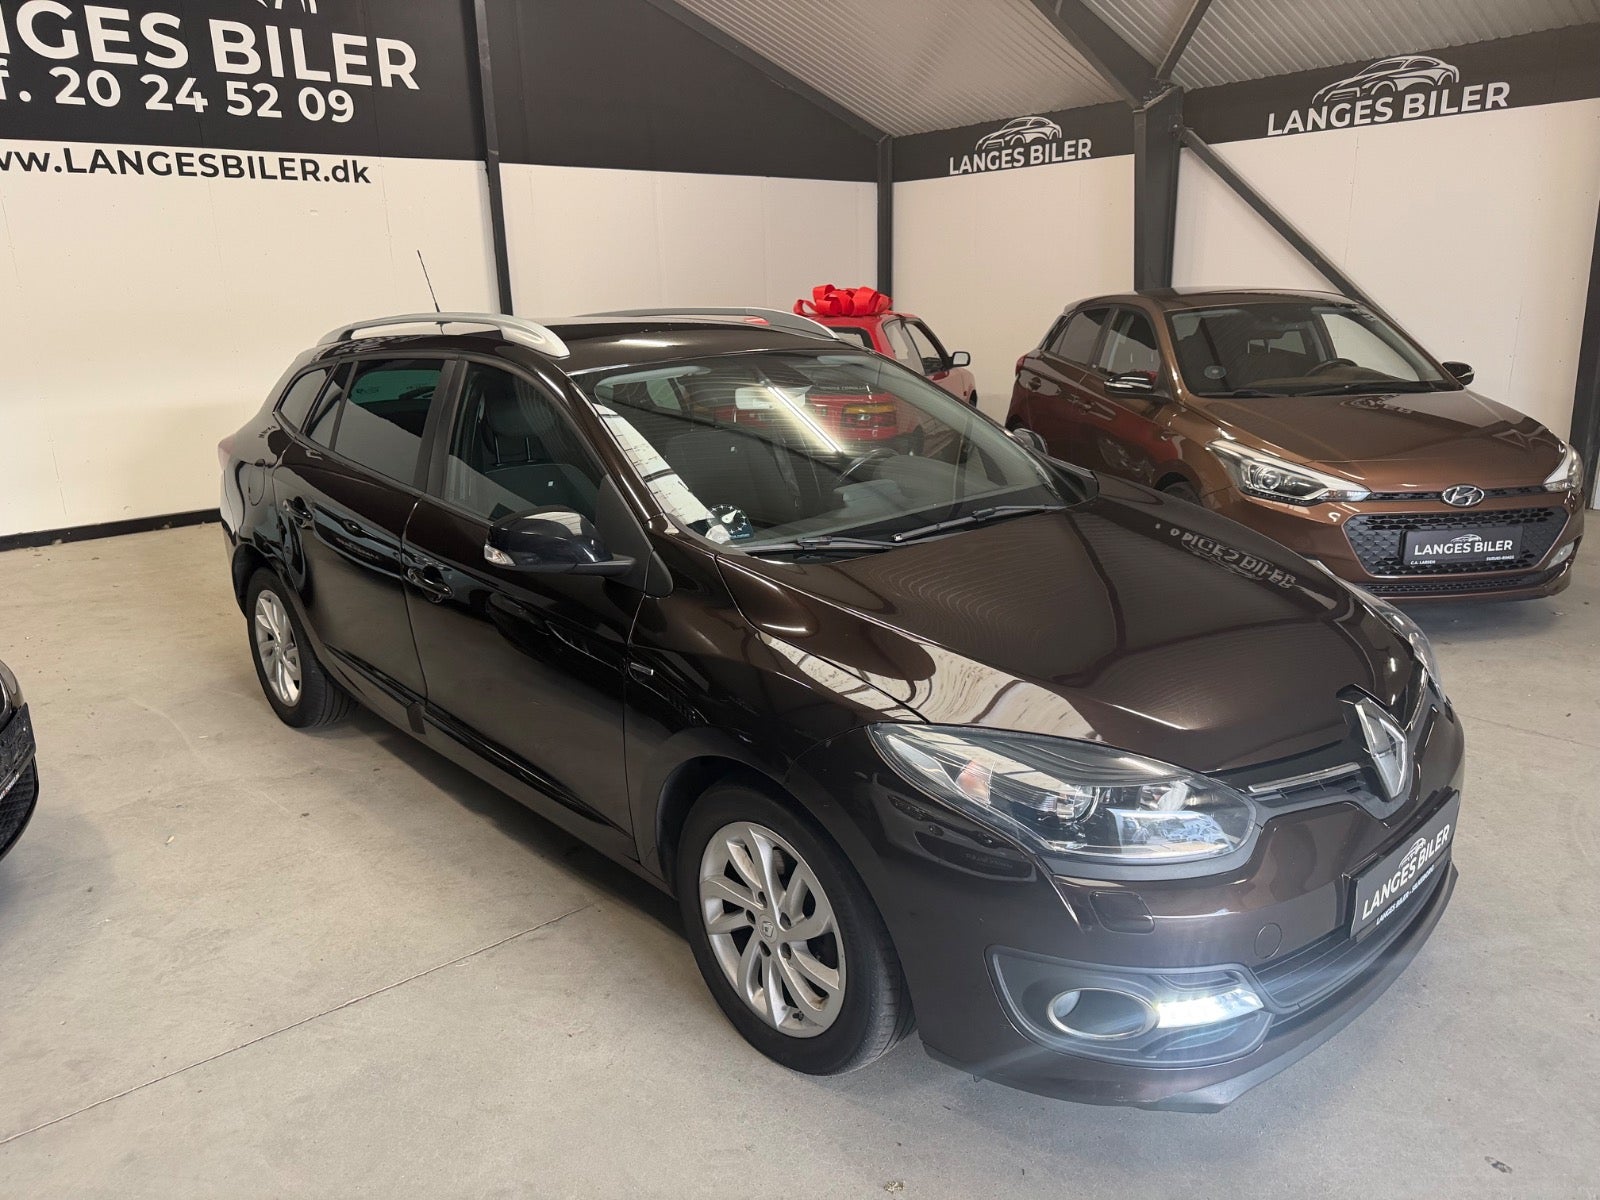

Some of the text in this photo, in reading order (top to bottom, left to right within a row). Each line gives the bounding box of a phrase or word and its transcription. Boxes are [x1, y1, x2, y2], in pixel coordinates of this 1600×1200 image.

[208, 18, 420, 91] BILER
[48, 66, 122, 108] 20
[139, 73, 209, 114] 24
[225, 80, 283, 119] 52
[297, 86, 355, 124] 09
[1267, 82, 1510, 136] LANGES BILER
[948, 138, 1092, 175] LANGES BILER
[1414, 540, 1513, 555] LANGES BILER
[1362, 861, 1416, 920] LANGES
[1417, 824, 1450, 870] BILER
